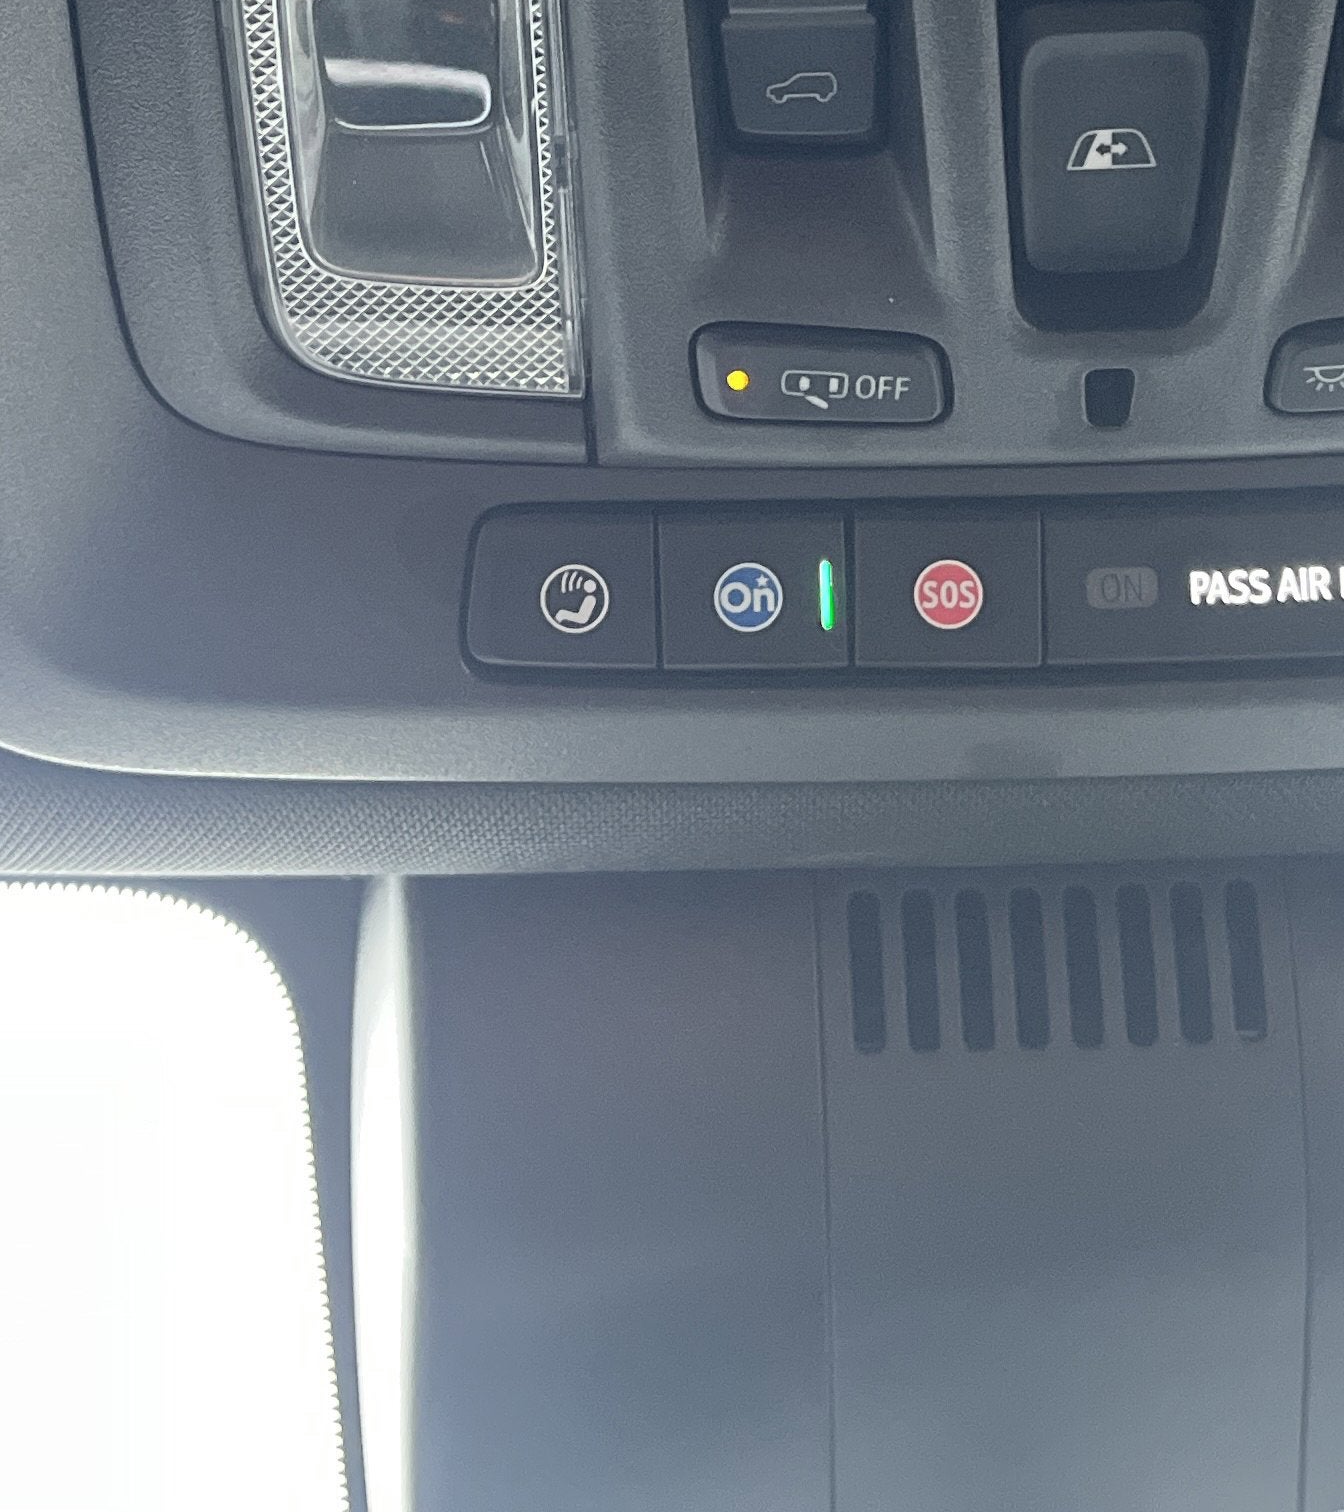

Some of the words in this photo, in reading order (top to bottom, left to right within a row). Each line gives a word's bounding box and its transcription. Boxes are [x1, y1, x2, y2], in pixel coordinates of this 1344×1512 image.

[854, 374, 911, 402] OFF
[921, 579, 977, 610] SOS
[1099, 573, 1144, 604] ON
[1188, 568, 1273, 606] PASS
[1276, 565, 1335, 603] AIR
